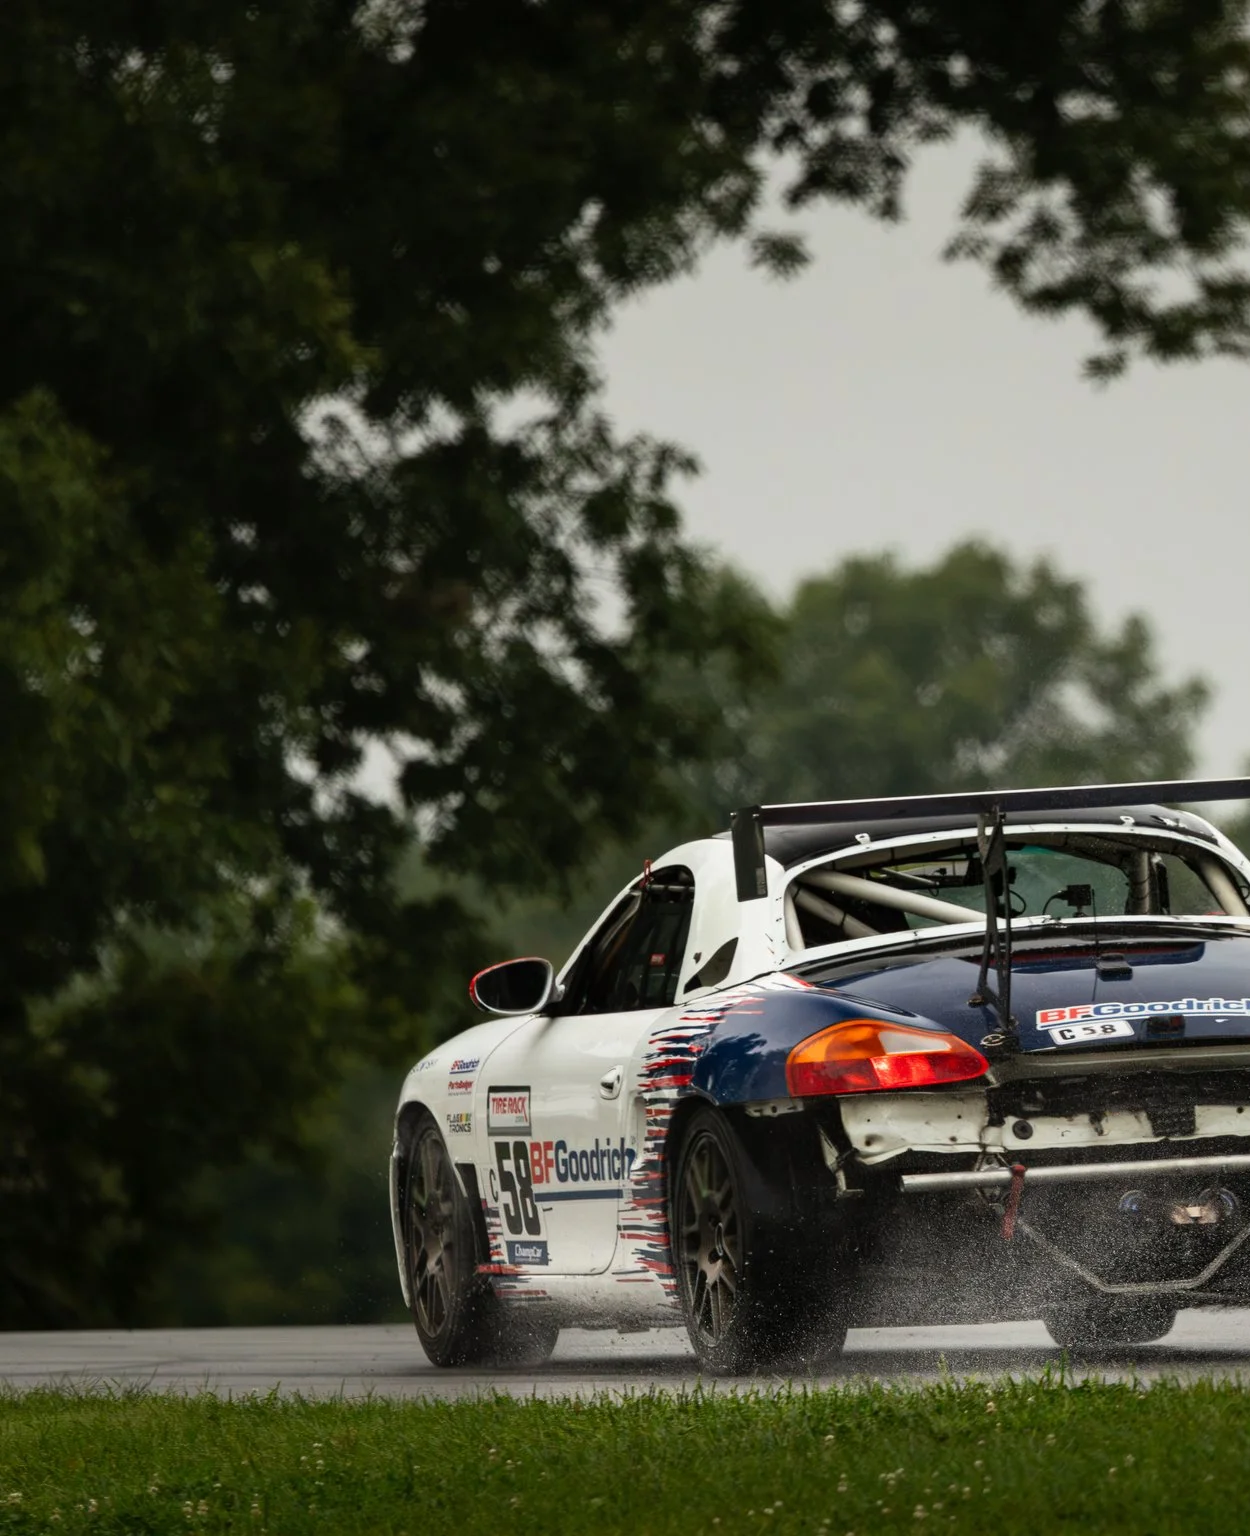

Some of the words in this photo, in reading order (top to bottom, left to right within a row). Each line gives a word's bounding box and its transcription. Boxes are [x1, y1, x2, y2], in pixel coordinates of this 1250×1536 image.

[1059, 1028, 1075, 1041] C
[1082, 1024, 1116, 1036] 58
[491, 1096, 507, 1115] TIRE
[508, 1096, 528, 1122] RACK
[530, 1137, 636, 1184] BFGoodrich
[489, 1169, 499, 1202] C
[494, 1141, 541, 1235] 58
